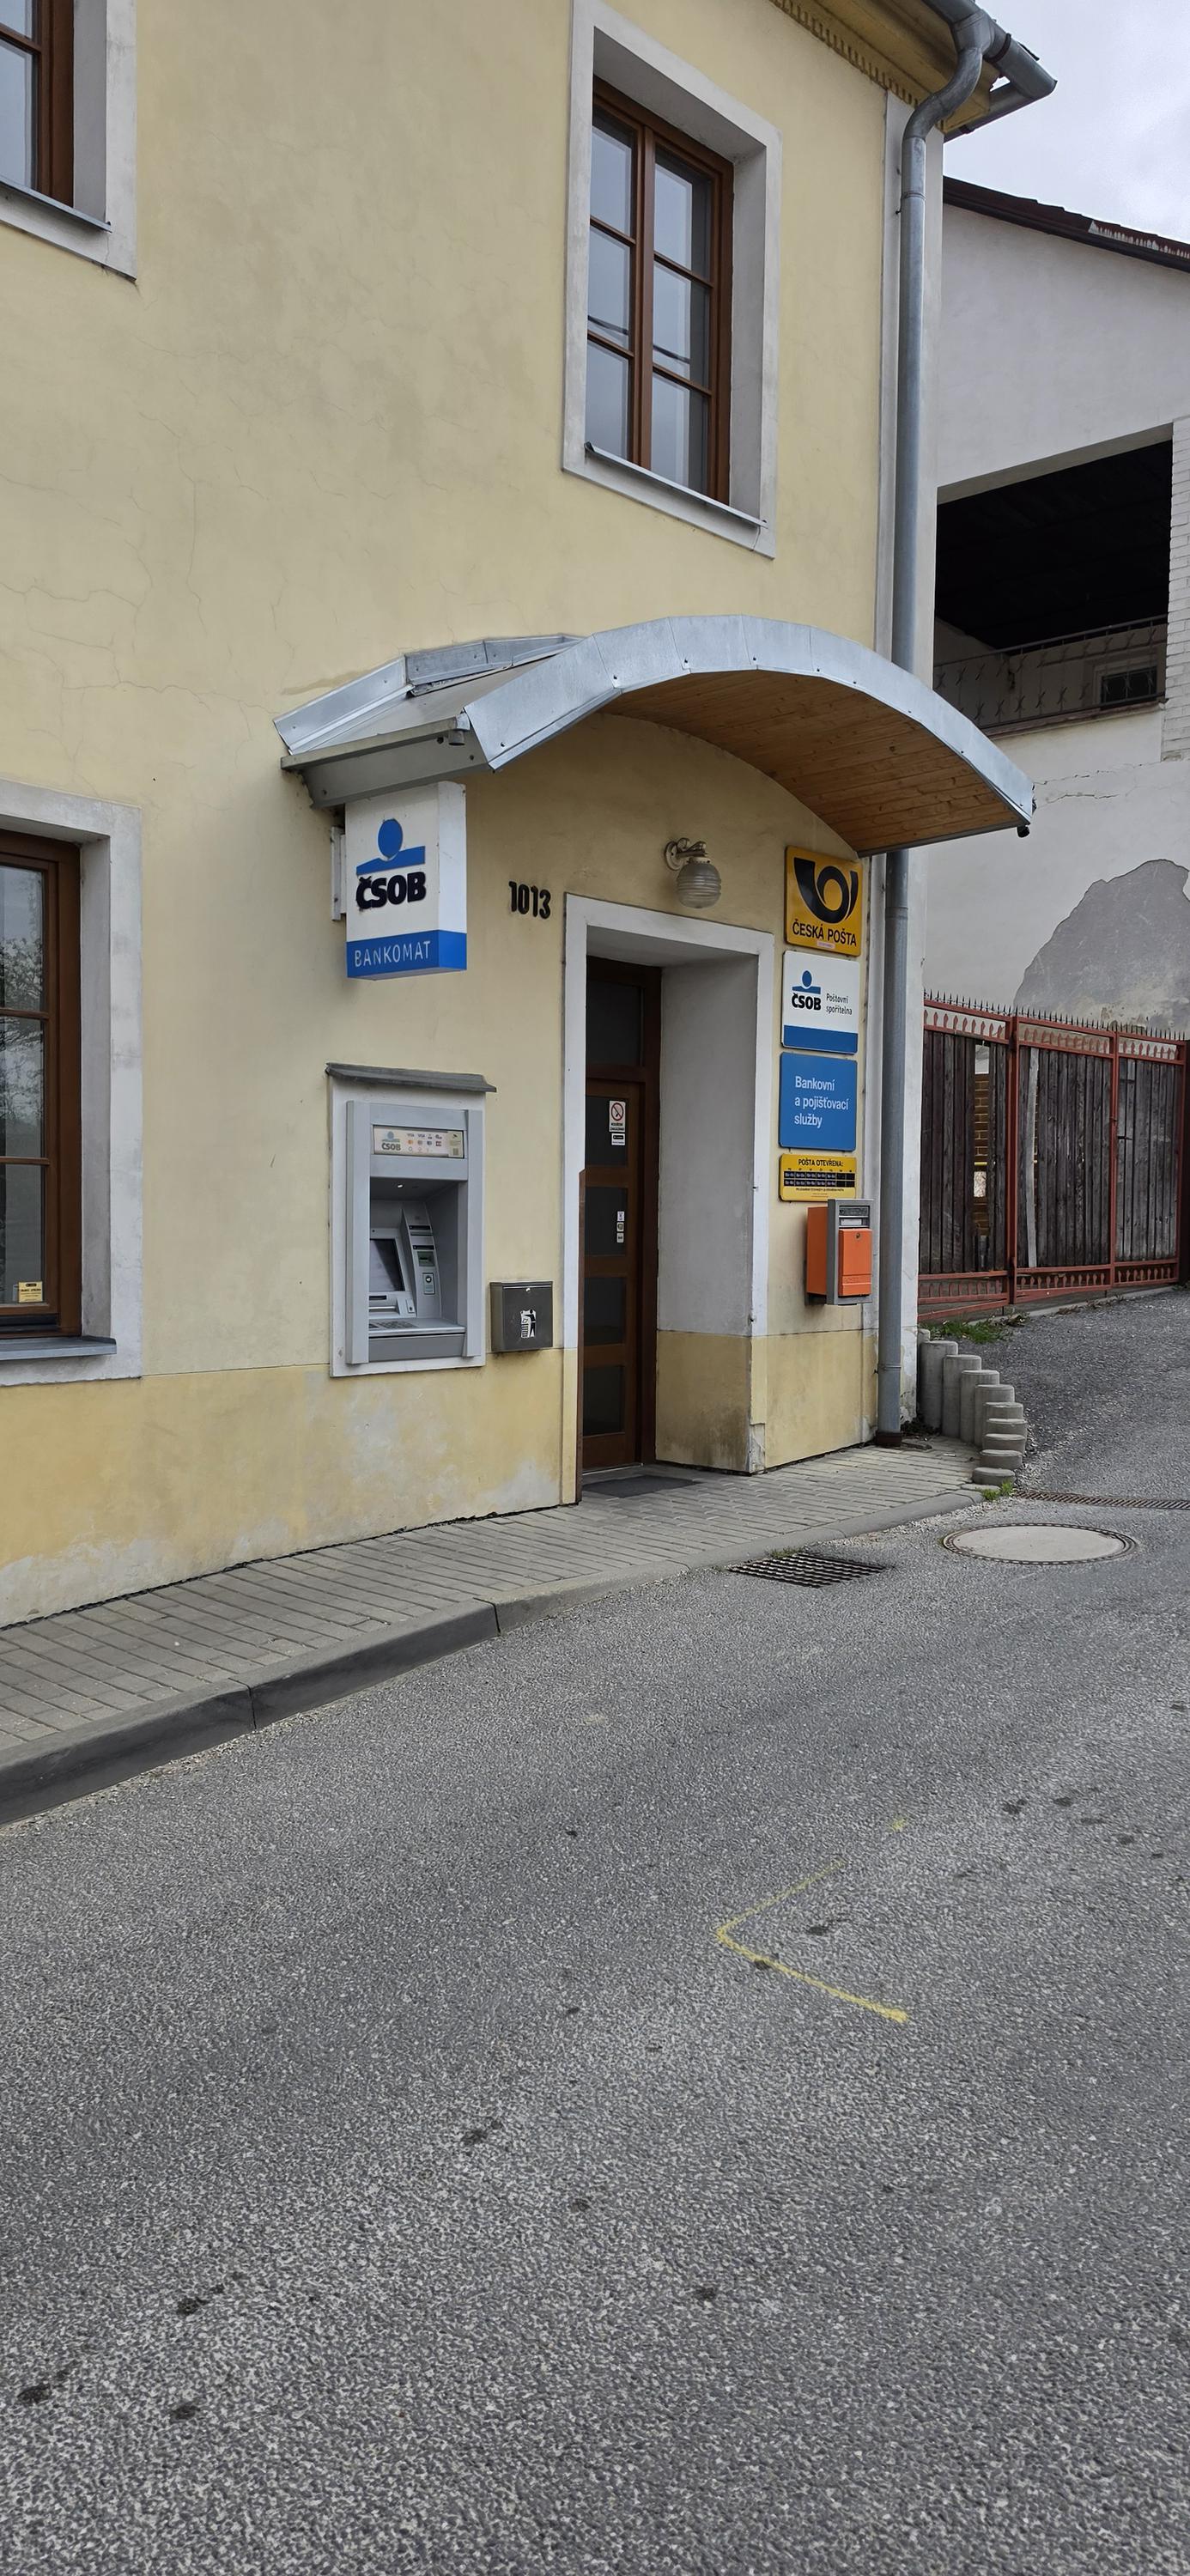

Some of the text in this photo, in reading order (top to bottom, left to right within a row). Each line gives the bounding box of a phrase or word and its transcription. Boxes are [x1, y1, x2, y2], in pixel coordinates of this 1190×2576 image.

[355, 872, 428, 910] ČSOB
[508, 881, 552, 920] 1013
[792, 918, 857, 946] ČESKÁ POŠTA
[355, 941, 431, 968] BANKOMAT
[792, 993, 822, 1011] ČSOB
[826, 993, 849, 1004] Poštovní
[826, 1005, 853, 1015] spořitelna
[795, 1075, 835, 1091] Bankovní
[794, 1096, 849, 1110] a pojišťovací
[794, 1113, 823, 1128] služby
[798, 1157, 815, 1166] POŠTA
